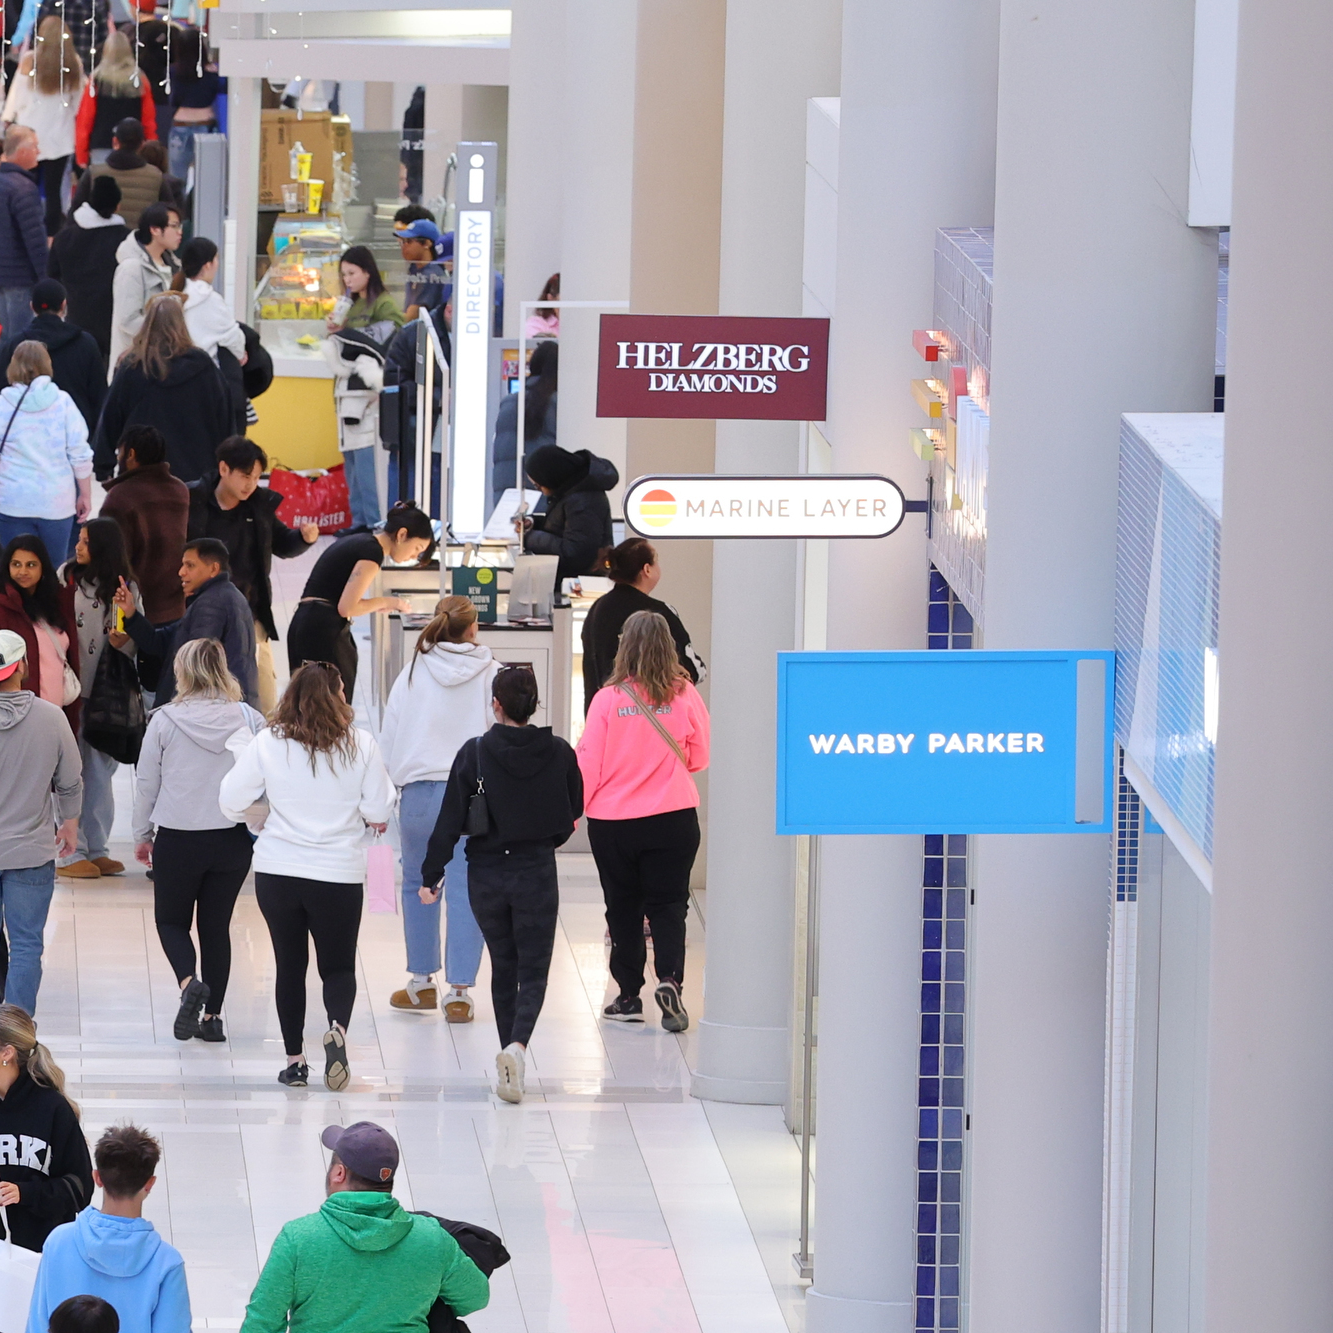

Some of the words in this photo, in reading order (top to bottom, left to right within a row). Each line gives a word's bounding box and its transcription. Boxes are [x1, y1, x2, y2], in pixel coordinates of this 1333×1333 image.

[465, 217, 483, 334] DIRECTORY
[616, 342, 810, 372] HELZBERG
[648, 374, 777, 394] DIAMONDS
[686, 499, 790, 518] MARINE
[804, 499, 887, 518] LAYER
[808, 733, 915, 755] WARBY
[927, 732, 1045, 754] PARKER
